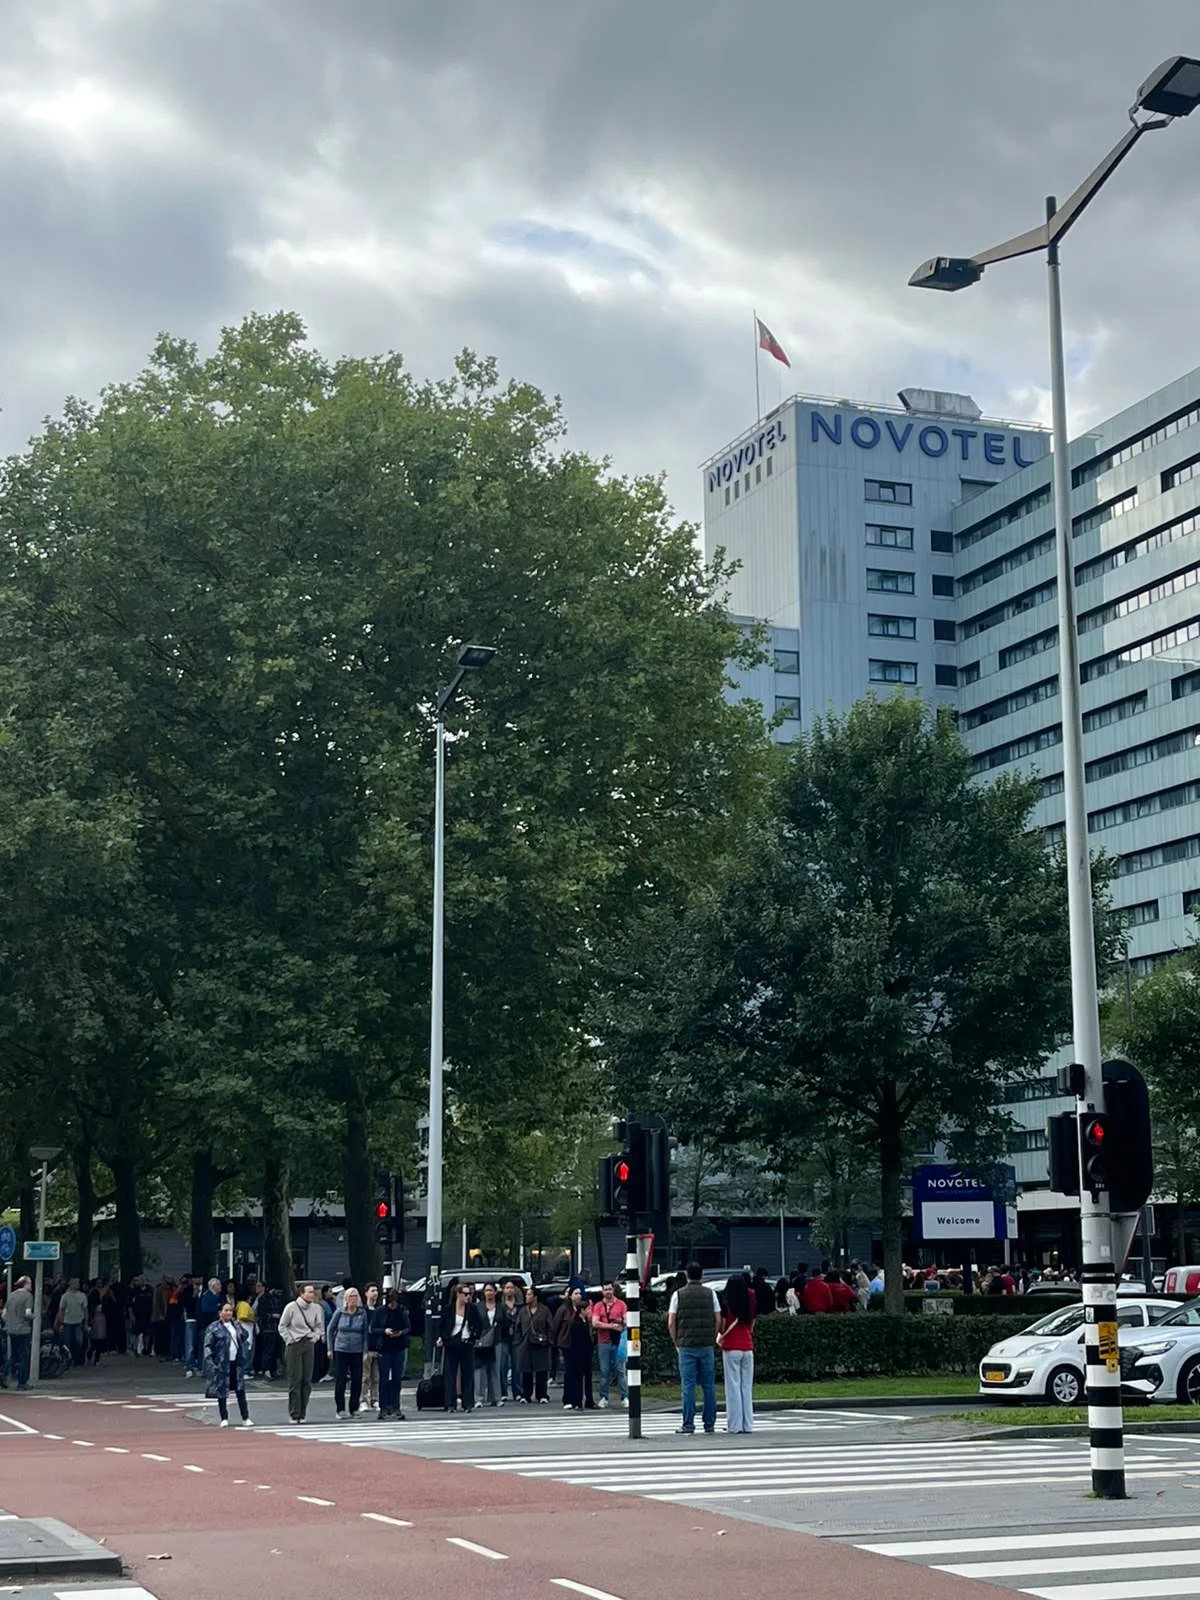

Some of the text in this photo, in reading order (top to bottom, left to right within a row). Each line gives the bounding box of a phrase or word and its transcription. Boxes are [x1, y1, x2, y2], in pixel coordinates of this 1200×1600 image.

[811, 411, 1034, 468] NOVOTEL
[708, 420, 787, 493] NOVOTEL
[927, 1178, 986, 1188] NOVOTEL
[936, 1216, 981, 1225] Welcome
